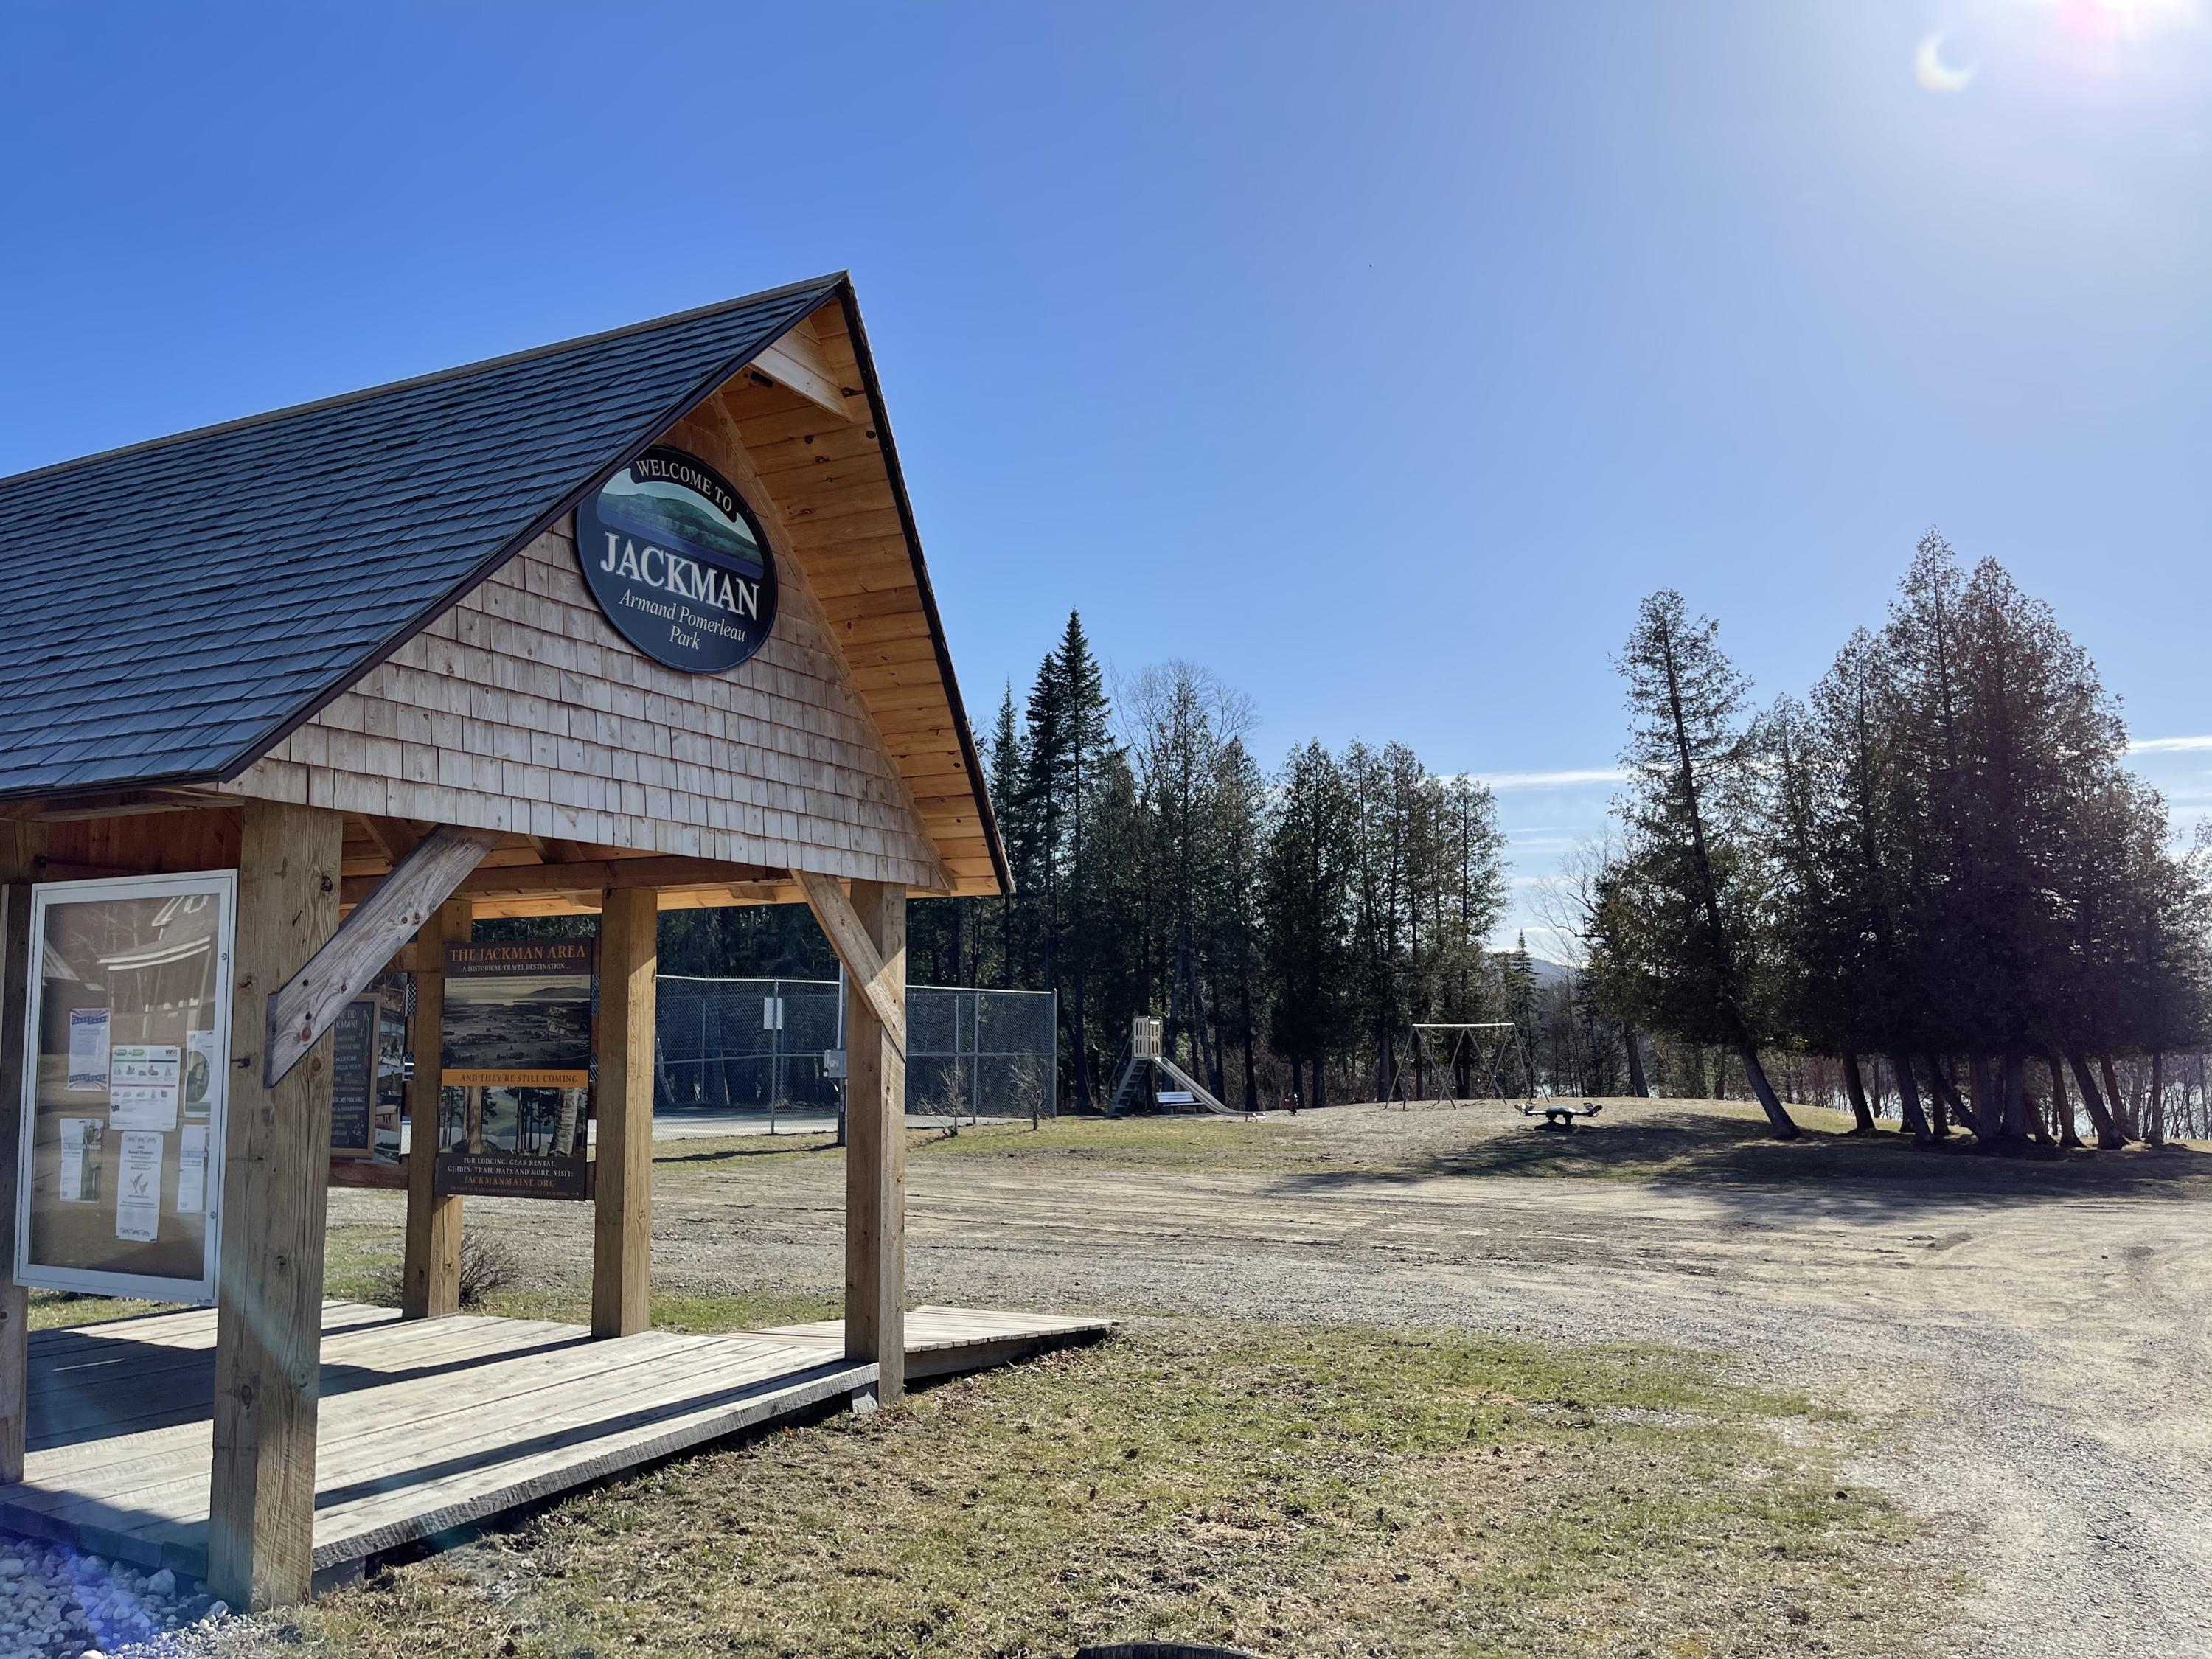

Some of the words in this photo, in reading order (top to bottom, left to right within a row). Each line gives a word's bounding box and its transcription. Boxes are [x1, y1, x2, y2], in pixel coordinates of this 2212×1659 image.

[636, 459, 712, 496] WELCOME
[714, 485, 733, 512] TO
[599, 530, 760, 621] JACKMAN
[619, 588, 676, 620] Armand
[678, 606, 745, 642] Pomerleau
[668, 625, 700, 650] Park
[449, 949, 476, 961] THE
[479, 946, 544, 962] JACKMAN
[547, 945, 586, 959] AREA
[467, 964, 502, 973] HISTORICAL
[526, 962, 566, 971] DESTINATION
[460, 1074, 478, 1082] AND
[480, 1074, 515, 1083] THEY'RE
[517, 1074, 540, 1083] STILL
[543, 1074, 579, 1084] COMING
